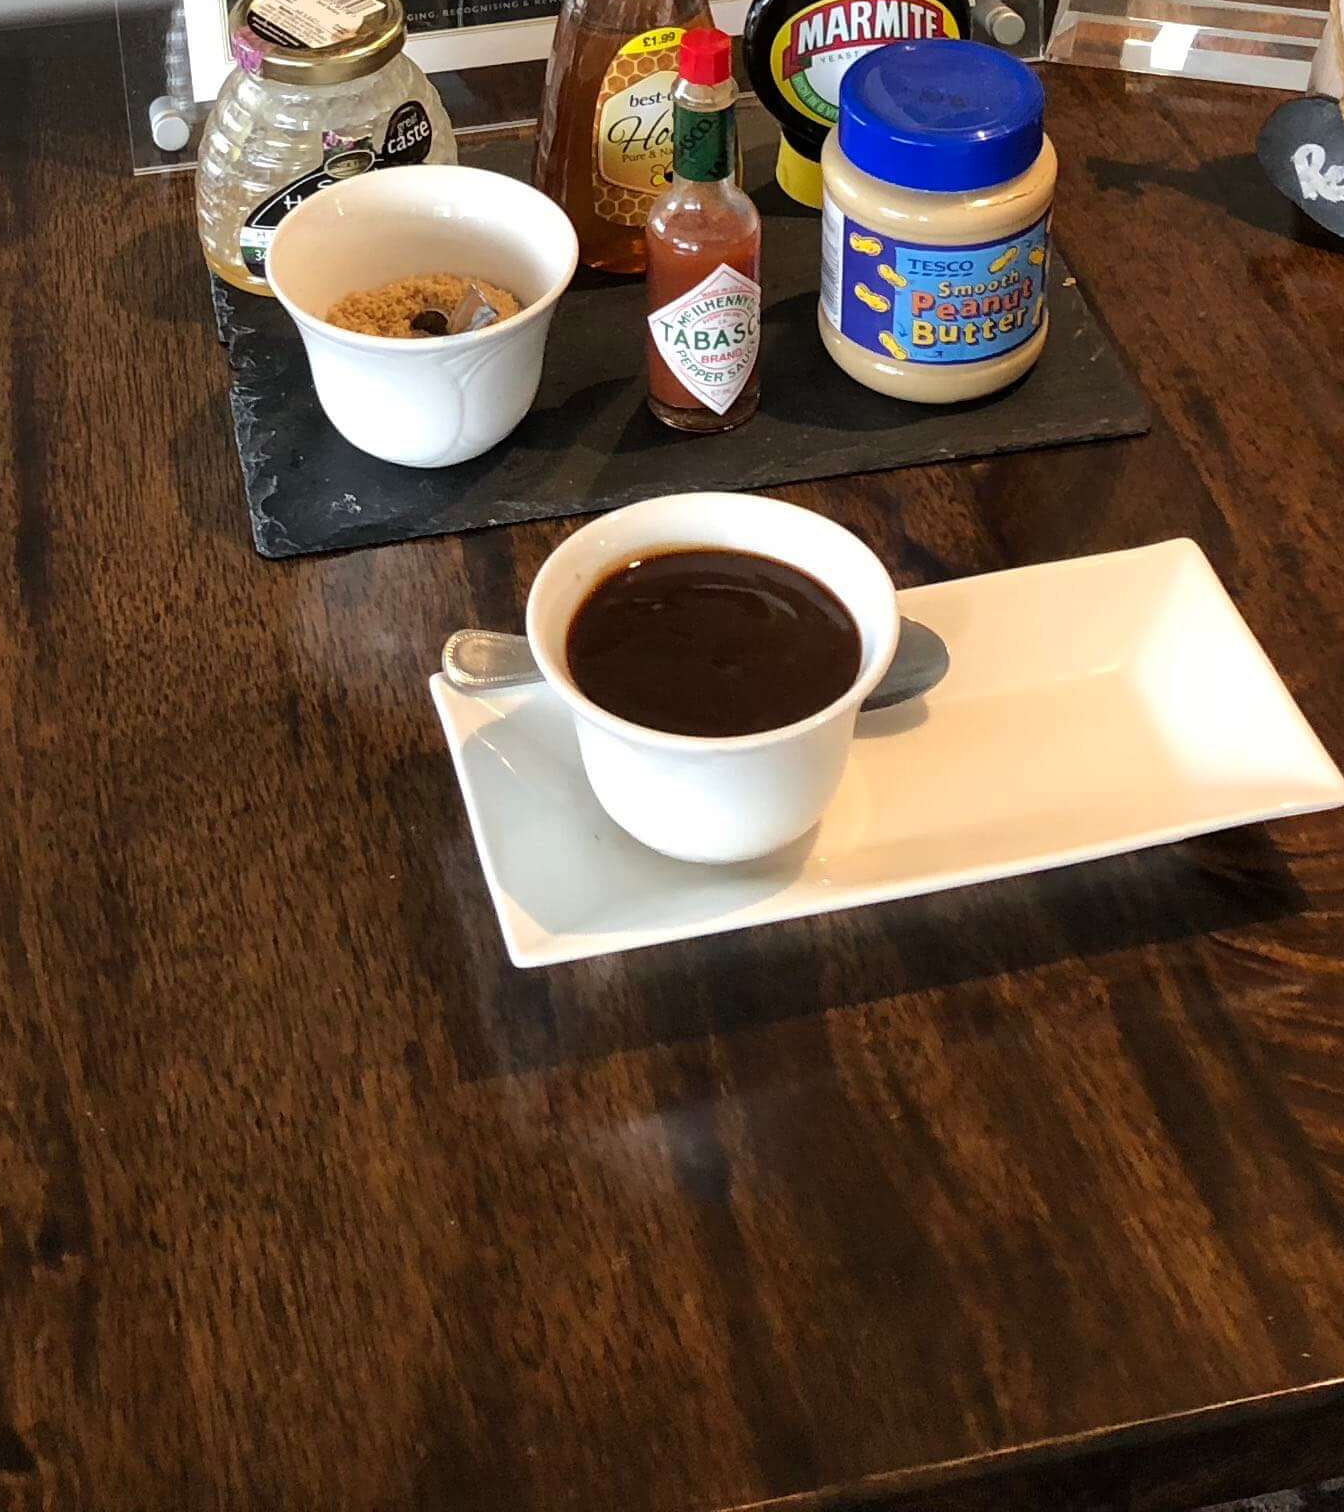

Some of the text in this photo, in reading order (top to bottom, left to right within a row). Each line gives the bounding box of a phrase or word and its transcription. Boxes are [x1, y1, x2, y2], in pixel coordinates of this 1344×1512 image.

[643, 31, 676, 47] £1.99
[797, 0, 938, 55] MARMITE
[607, 109, 674, 154] Ho
[907, 257, 975, 273] TESCO
[911, 276, 1034, 322] Peanut
[937, 270, 1022, 299] Smooth
[660, 314, 761, 351] TABASC
[911, 307, 1028, 348] Butter
[676, 350, 724, 382] PEPPER
[701, 348, 743, 364] BRAND
